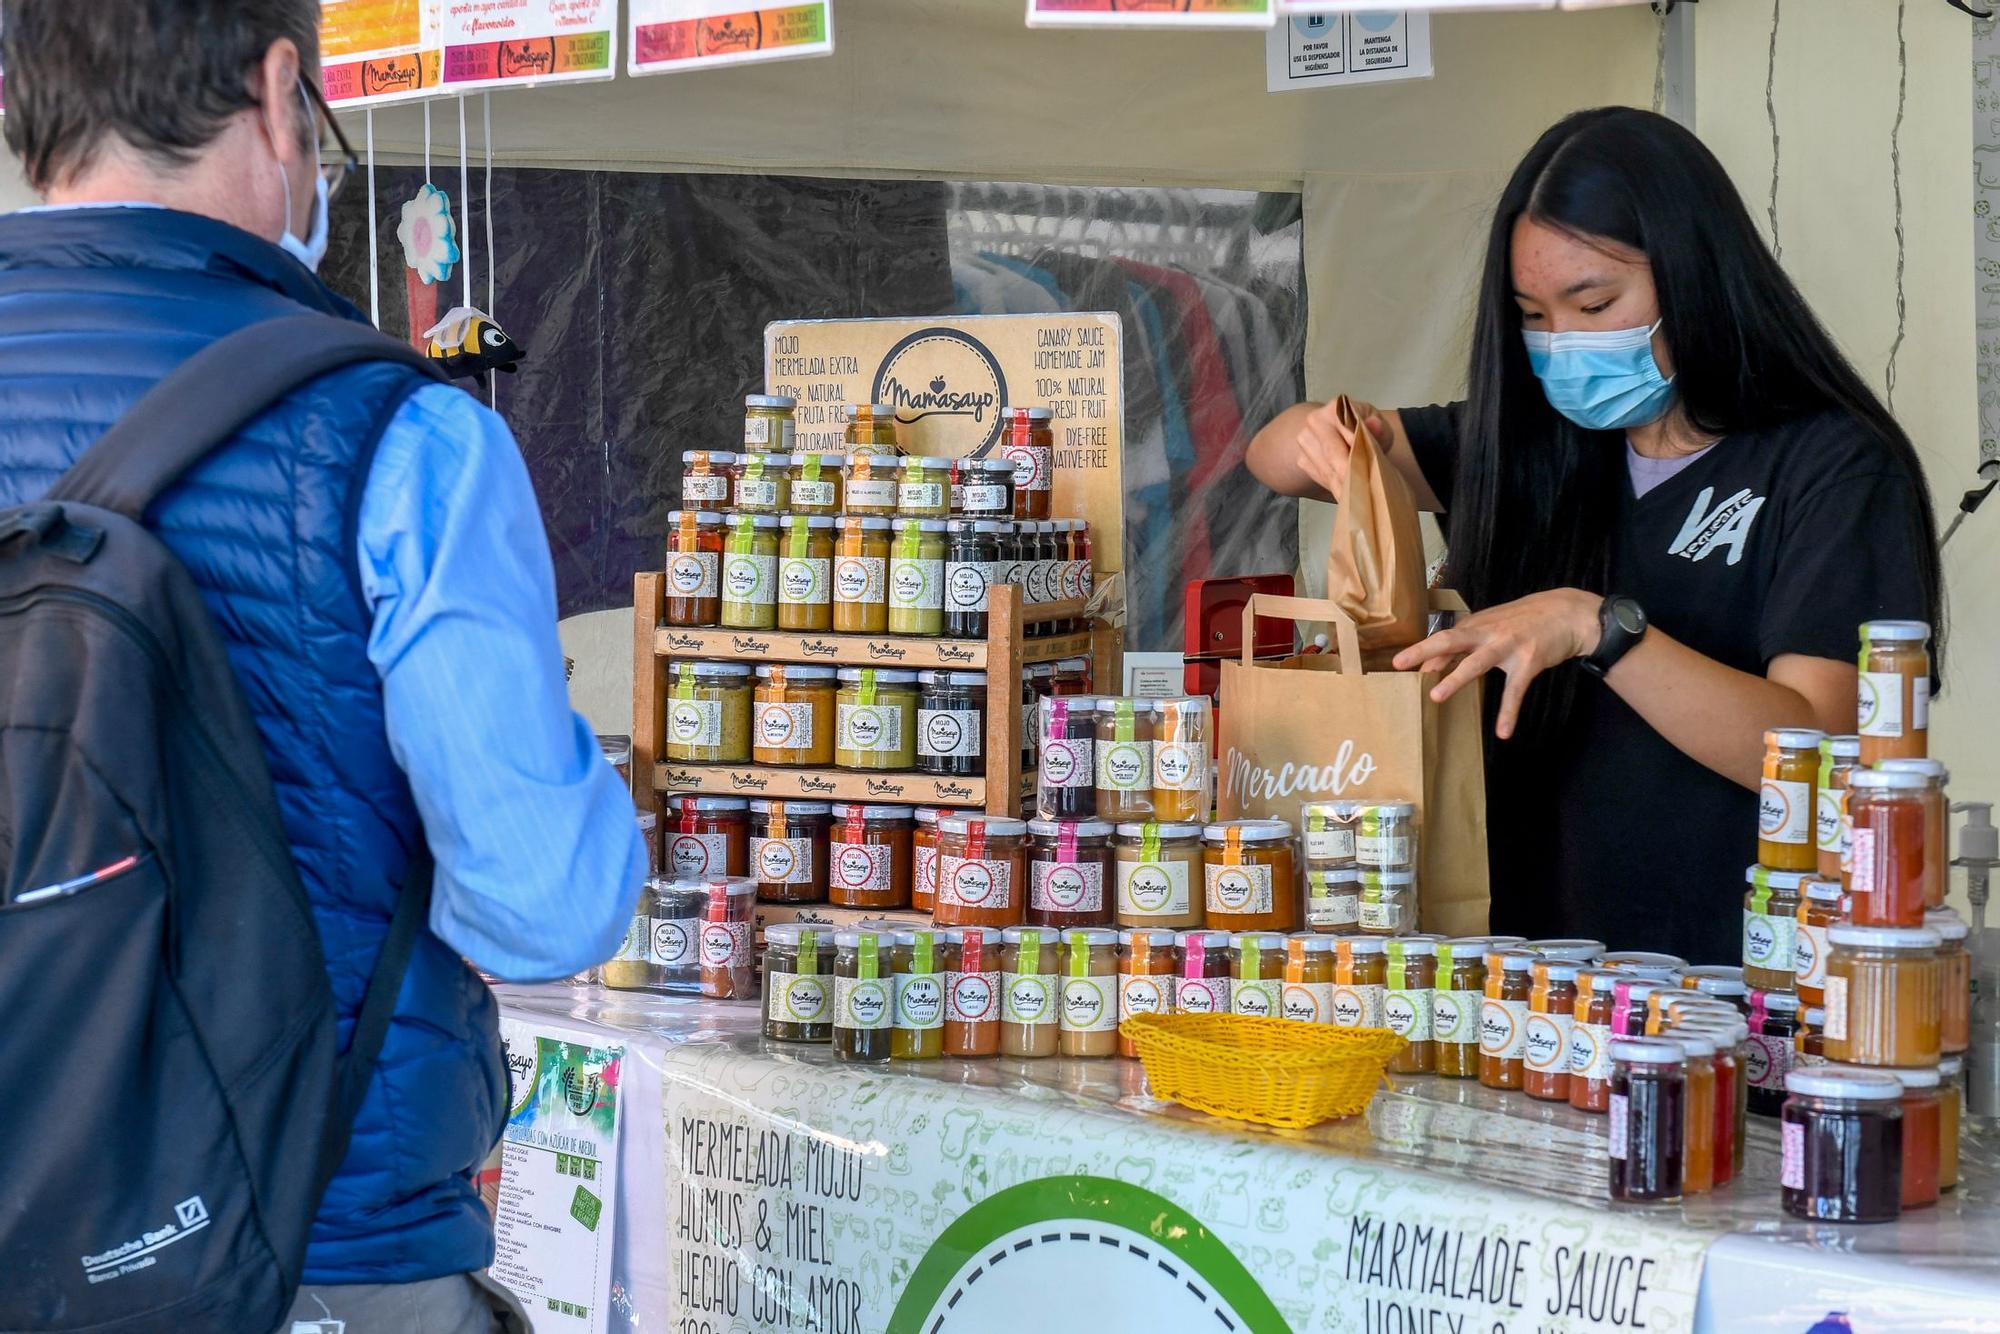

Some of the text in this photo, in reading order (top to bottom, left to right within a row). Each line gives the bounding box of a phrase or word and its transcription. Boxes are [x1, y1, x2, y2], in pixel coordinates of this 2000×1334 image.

[471, 18, 516, 36] flavonoides
[1303, 42, 1329, 52] POR FAVOR
[1364, 36, 1392, 45] MANTENGA
[504, 45, 549, 72] Mamasayo
[1293, 55, 1301, 63] USE
[1308, 51, 1341, 62] DISPENSADOR
[1359, 45, 1398, 56] LA DISTANCIA DE
[1365, 56, 1393, 66] SEGURIDAD
[368, 63, 416, 88] Mamasayo
[774, 335, 799, 355] MOJO
[1038, 327, 1105, 347] CANARY SAUCE
[774, 357, 859, 377] MERMELADA EXTRA
[1034, 350, 1106, 371] HOMEMADE JAM
[775, 383, 846, 403] 100% NATURAL
[1035, 377, 1107, 397] 100% NATURAL
[885, 376, 994, 423] Mamasayo
[798, 405, 825, 425] FRUTA
[1049, 399, 1106, 420] FRESH FRUIT
[1066, 426, 1108, 447] DYE-FREE
[1052, 449, 1108, 470] VATIVE-FREE
[953, 580, 982, 594] Mamasayo
[667, 634, 704, 651] Mamasayo
[733, 636, 770, 653] Mamasayo
[801, 639, 839, 657] Mamasayo
[868, 641, 906, 660] Mamasayo
[936, 644, 975, 663] Mamasayo
[930, 726, 958, 739] Mamasayo
[665, 770, 703, 788] Mamasayo
[731, 773, 768, 791] Mamasayo
[1226, 739, 1378, 810] Mercado
[799, 776, 837, 793] Mamasayo
[865, 778, 904, 796] Mamasayo
[934, 781, 973, 799] Mamasayo
[675, 850, 704, 865] Mamasayo
[764, 854, 791, 867] Mamasayo
[842, 859, 868, 873] Mamasayo
[958, 874, 988, 890] Mamasayo
[1051, 879, 1082, 894] Mamasayo
[1132, 879, 1167, 895] Mamasayo
[1219, 882, 1248, 896] Mamasayo
[790, 991, 823, 1005] Mamasayo
[852, 996, 884, 1010] Mamasayo
[904, 992, 940, 1009] Mamasayo
[957, 988, 989, 1004] Mamasayo
[1013, 990, 1044, 1006] Mamasayo
[1065, 994, 1100, 1011] Mamasayo
[1126, 992, 1157, 1006] Mamasayo
[1182, 995, 1211, 1010] Mamasayo
[1238, 999, 1268, 1014] Mamasayo
[509, 1052, 533, 1081] sayo
[537, 1130, 548, 1146] CON
[549, 1132, 569, 1151] AZÚCAR
[570, 1139, 577, 1153] DE
[578, 1139, 598, 1157] ABEDUL
[681, 1116, 863, 1201] MERMELADA MOJO
[680, 1182, 743, 1250] HUMUS
[755, 1198, 772, 1253] &
[81, 1223, 179, 1267] Deutsche Bank
[1346, 1215, 1655, 1329] MARMALADE SAUCE
[518, 1296, 532, 1305] OSQUE
[680, 1249, 862, 1334] HECHO CON AMOR
